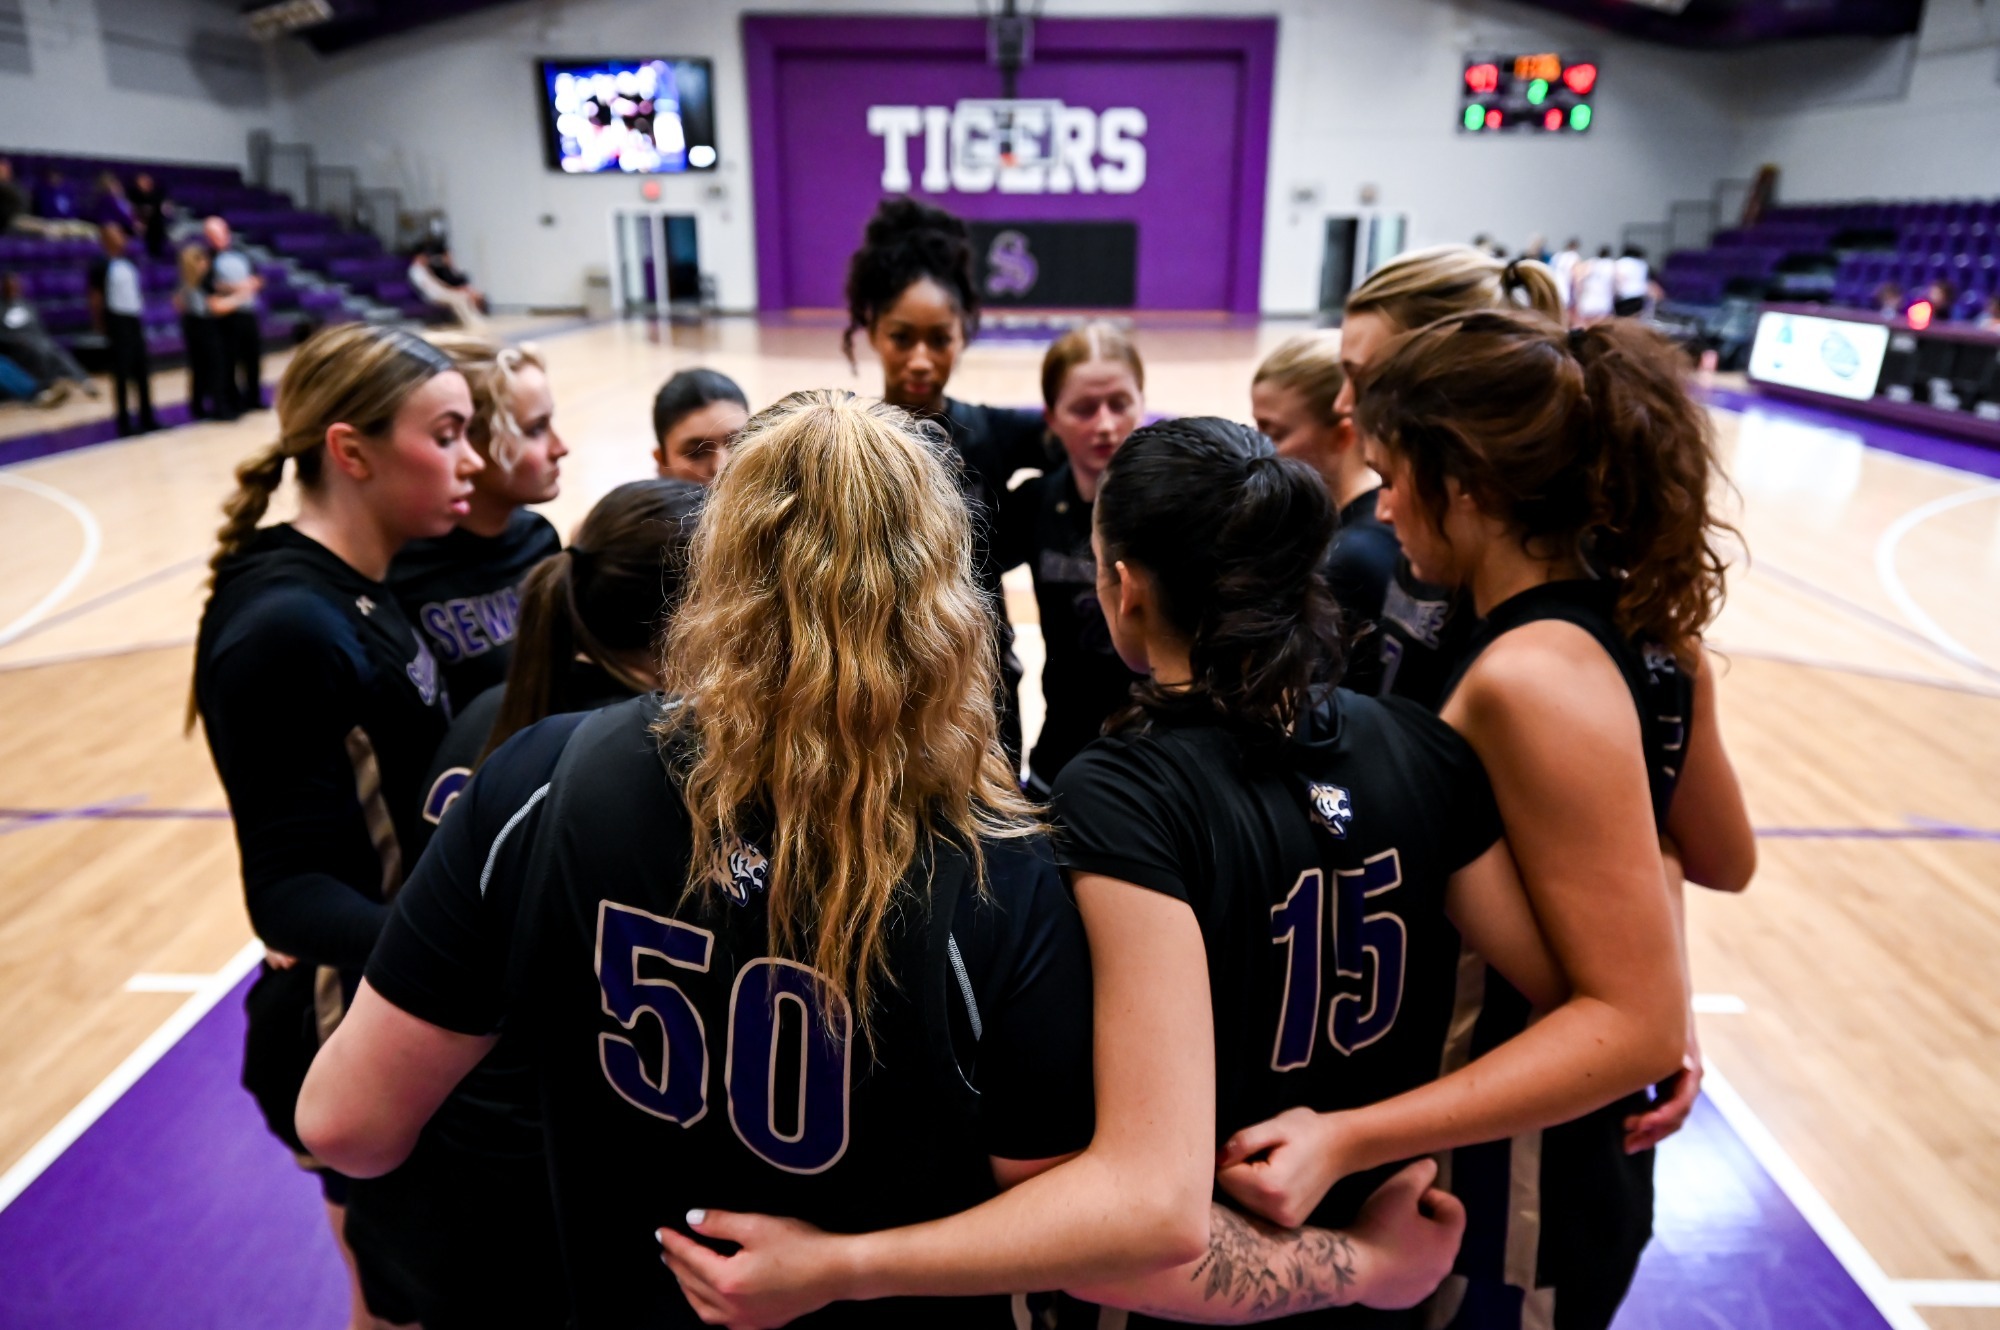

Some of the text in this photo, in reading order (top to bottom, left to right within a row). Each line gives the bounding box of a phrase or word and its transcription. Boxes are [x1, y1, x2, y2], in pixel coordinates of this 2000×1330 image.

[866, 104, 1148, 193] TIGERS
[594, 898, 852, 1175] 50
[1270, 847, 1407, 1073] 15
